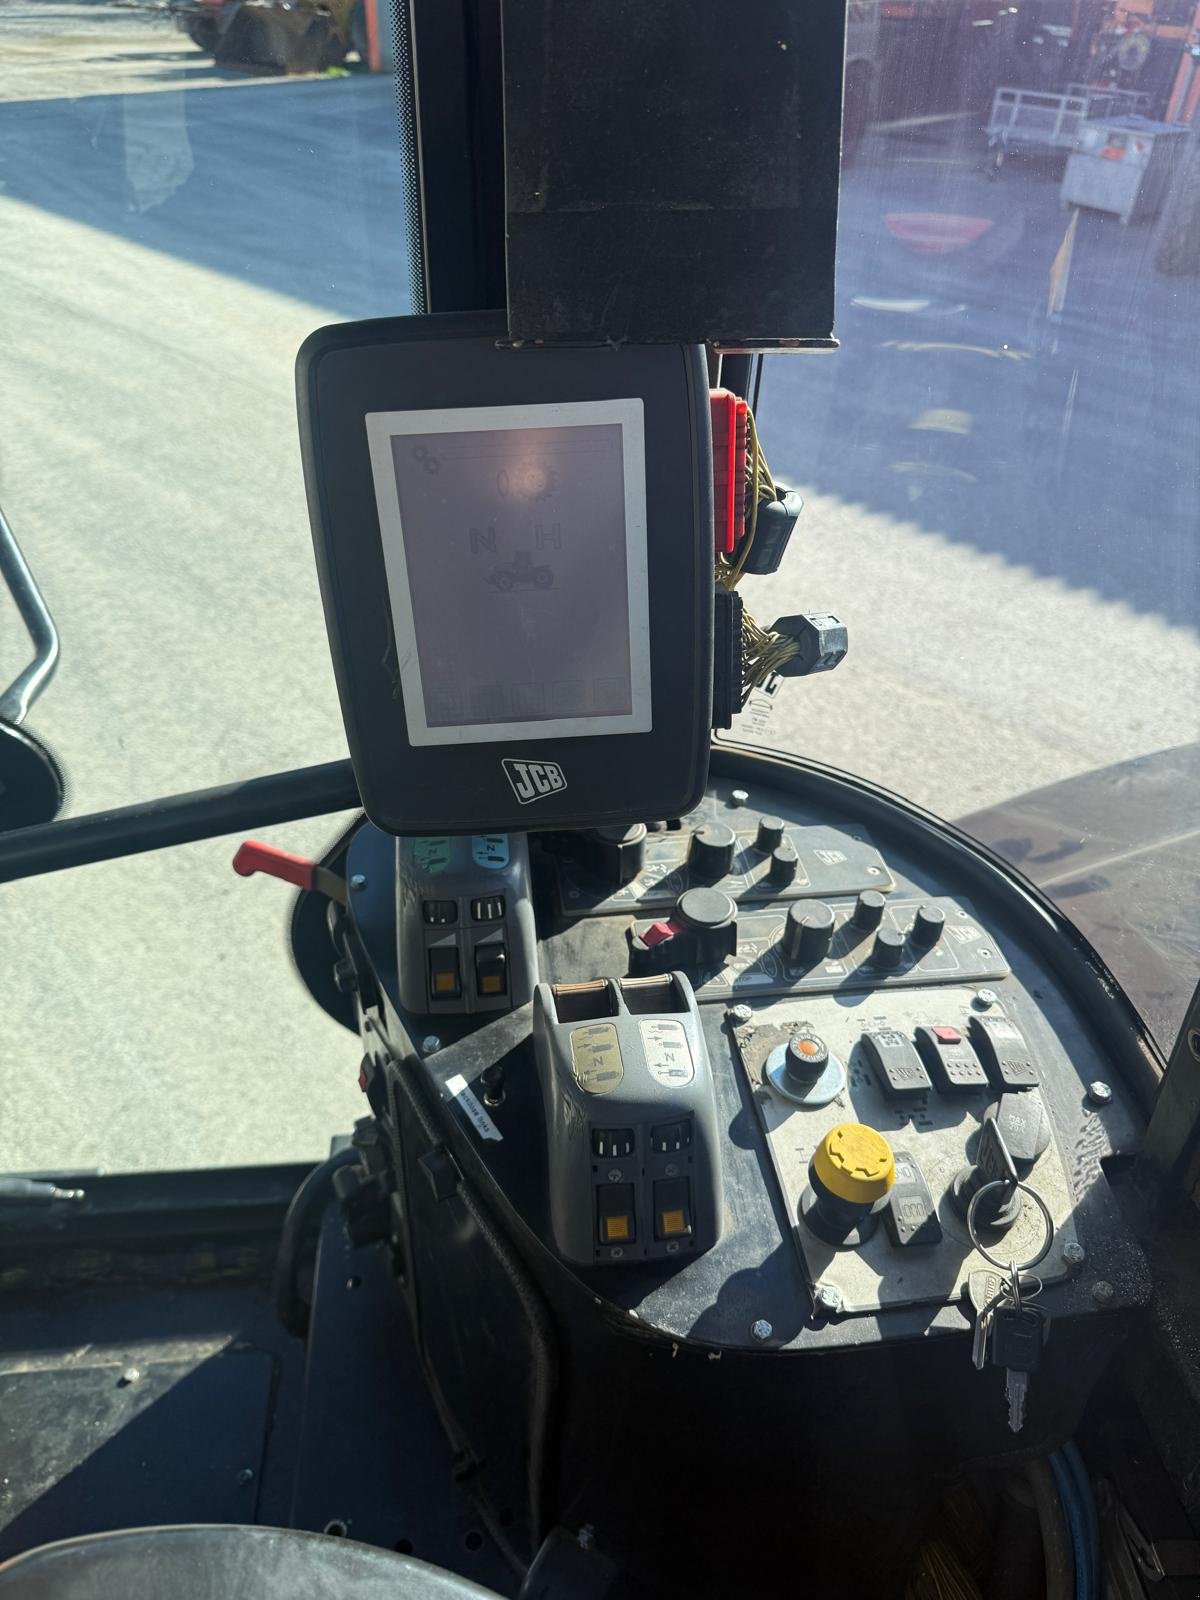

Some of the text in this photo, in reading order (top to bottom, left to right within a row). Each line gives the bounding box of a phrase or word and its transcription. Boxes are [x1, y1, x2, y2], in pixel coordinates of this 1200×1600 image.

[469, 525, 496, 553] N
[535, 523, 561, 549] H
[512, 762, 563, 798] JCB
